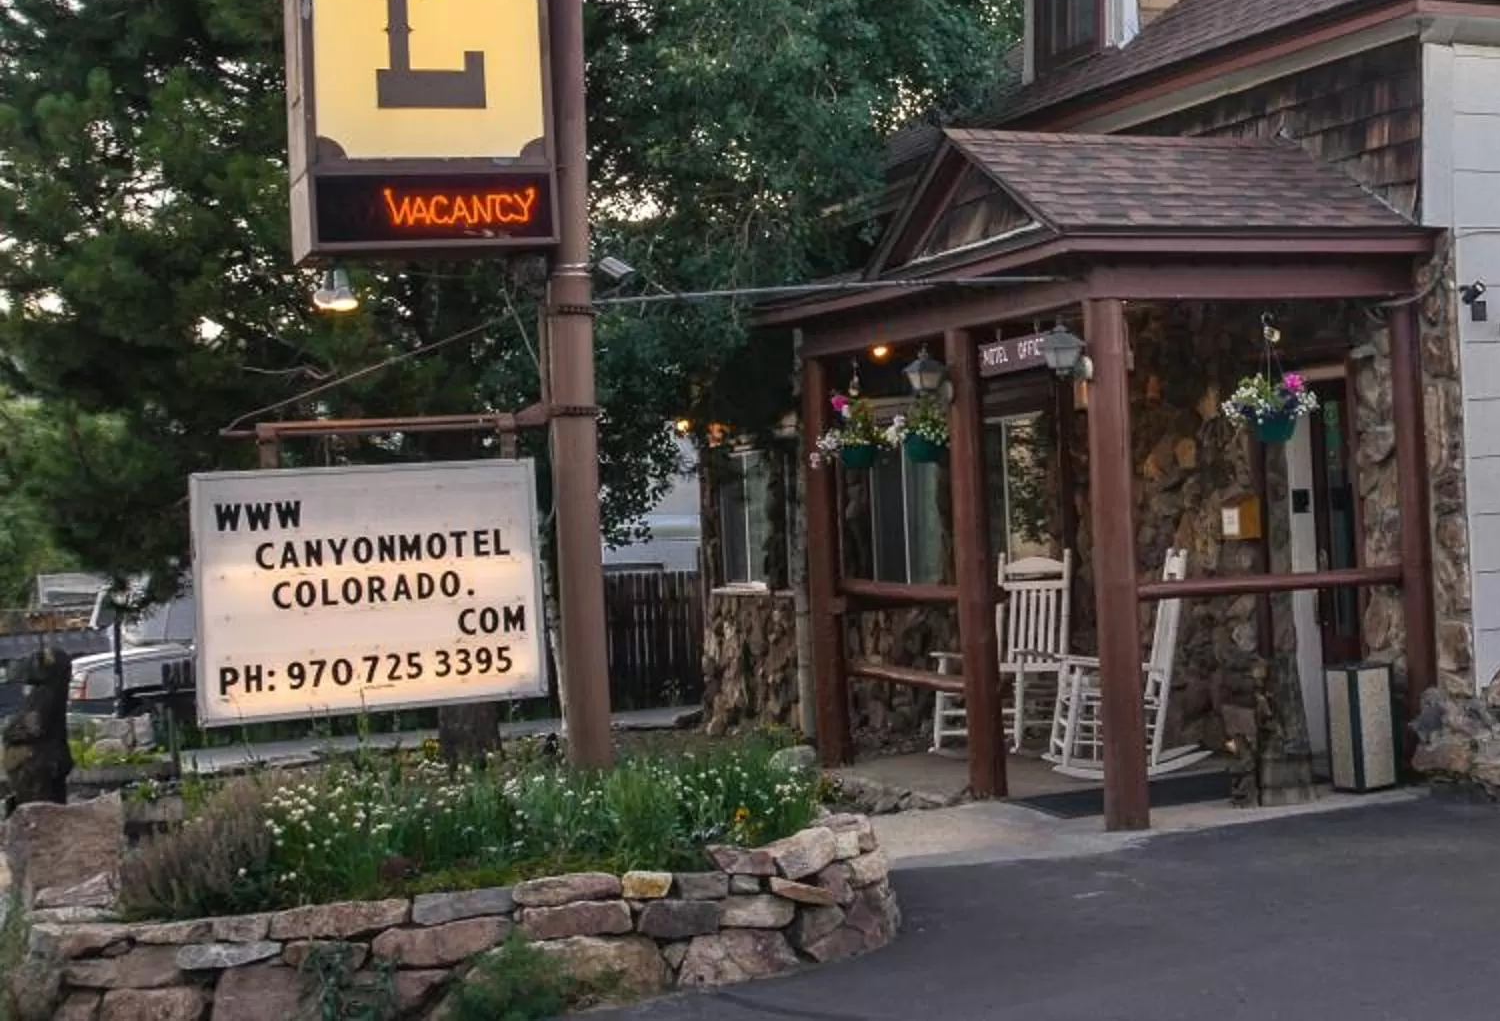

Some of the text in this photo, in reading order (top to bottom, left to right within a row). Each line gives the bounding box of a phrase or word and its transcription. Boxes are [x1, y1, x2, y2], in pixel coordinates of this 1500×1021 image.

[383, 187, 537, 226] VACANCY
[215, 500, 301, 531] WWW
[255, 529, 510, 570] CANYONMOTEL
[272, 570, 475, 609] COLORADO.
[458, 605, 526, 635] COM
[287, 658, 353, 690] 970
[362, 652, 423, 684] 725
[435, 646, 514, 677] 3395
